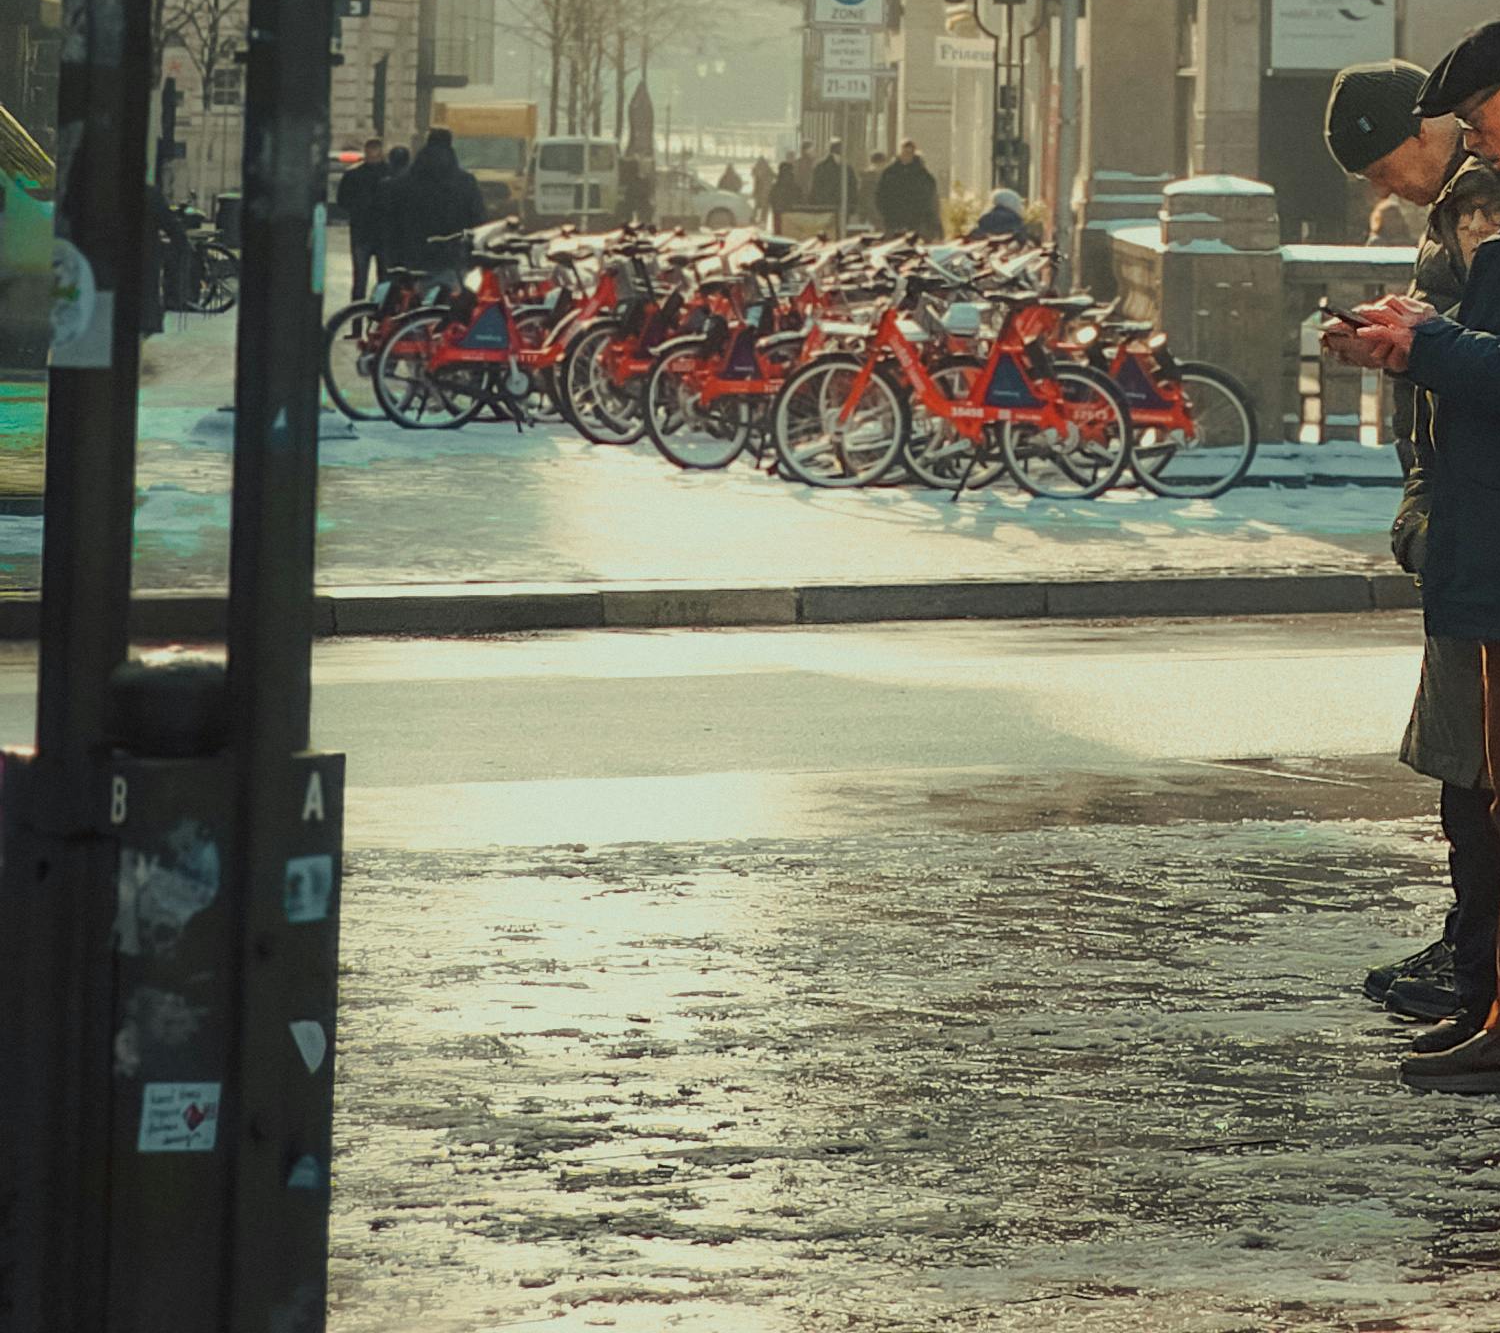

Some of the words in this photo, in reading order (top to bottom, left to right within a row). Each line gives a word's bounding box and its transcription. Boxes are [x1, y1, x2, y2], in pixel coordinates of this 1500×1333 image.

[831, 7, 865, 20] ZONE
[111, 776, 127, 824] B
[302, 771, 324, 821] A
